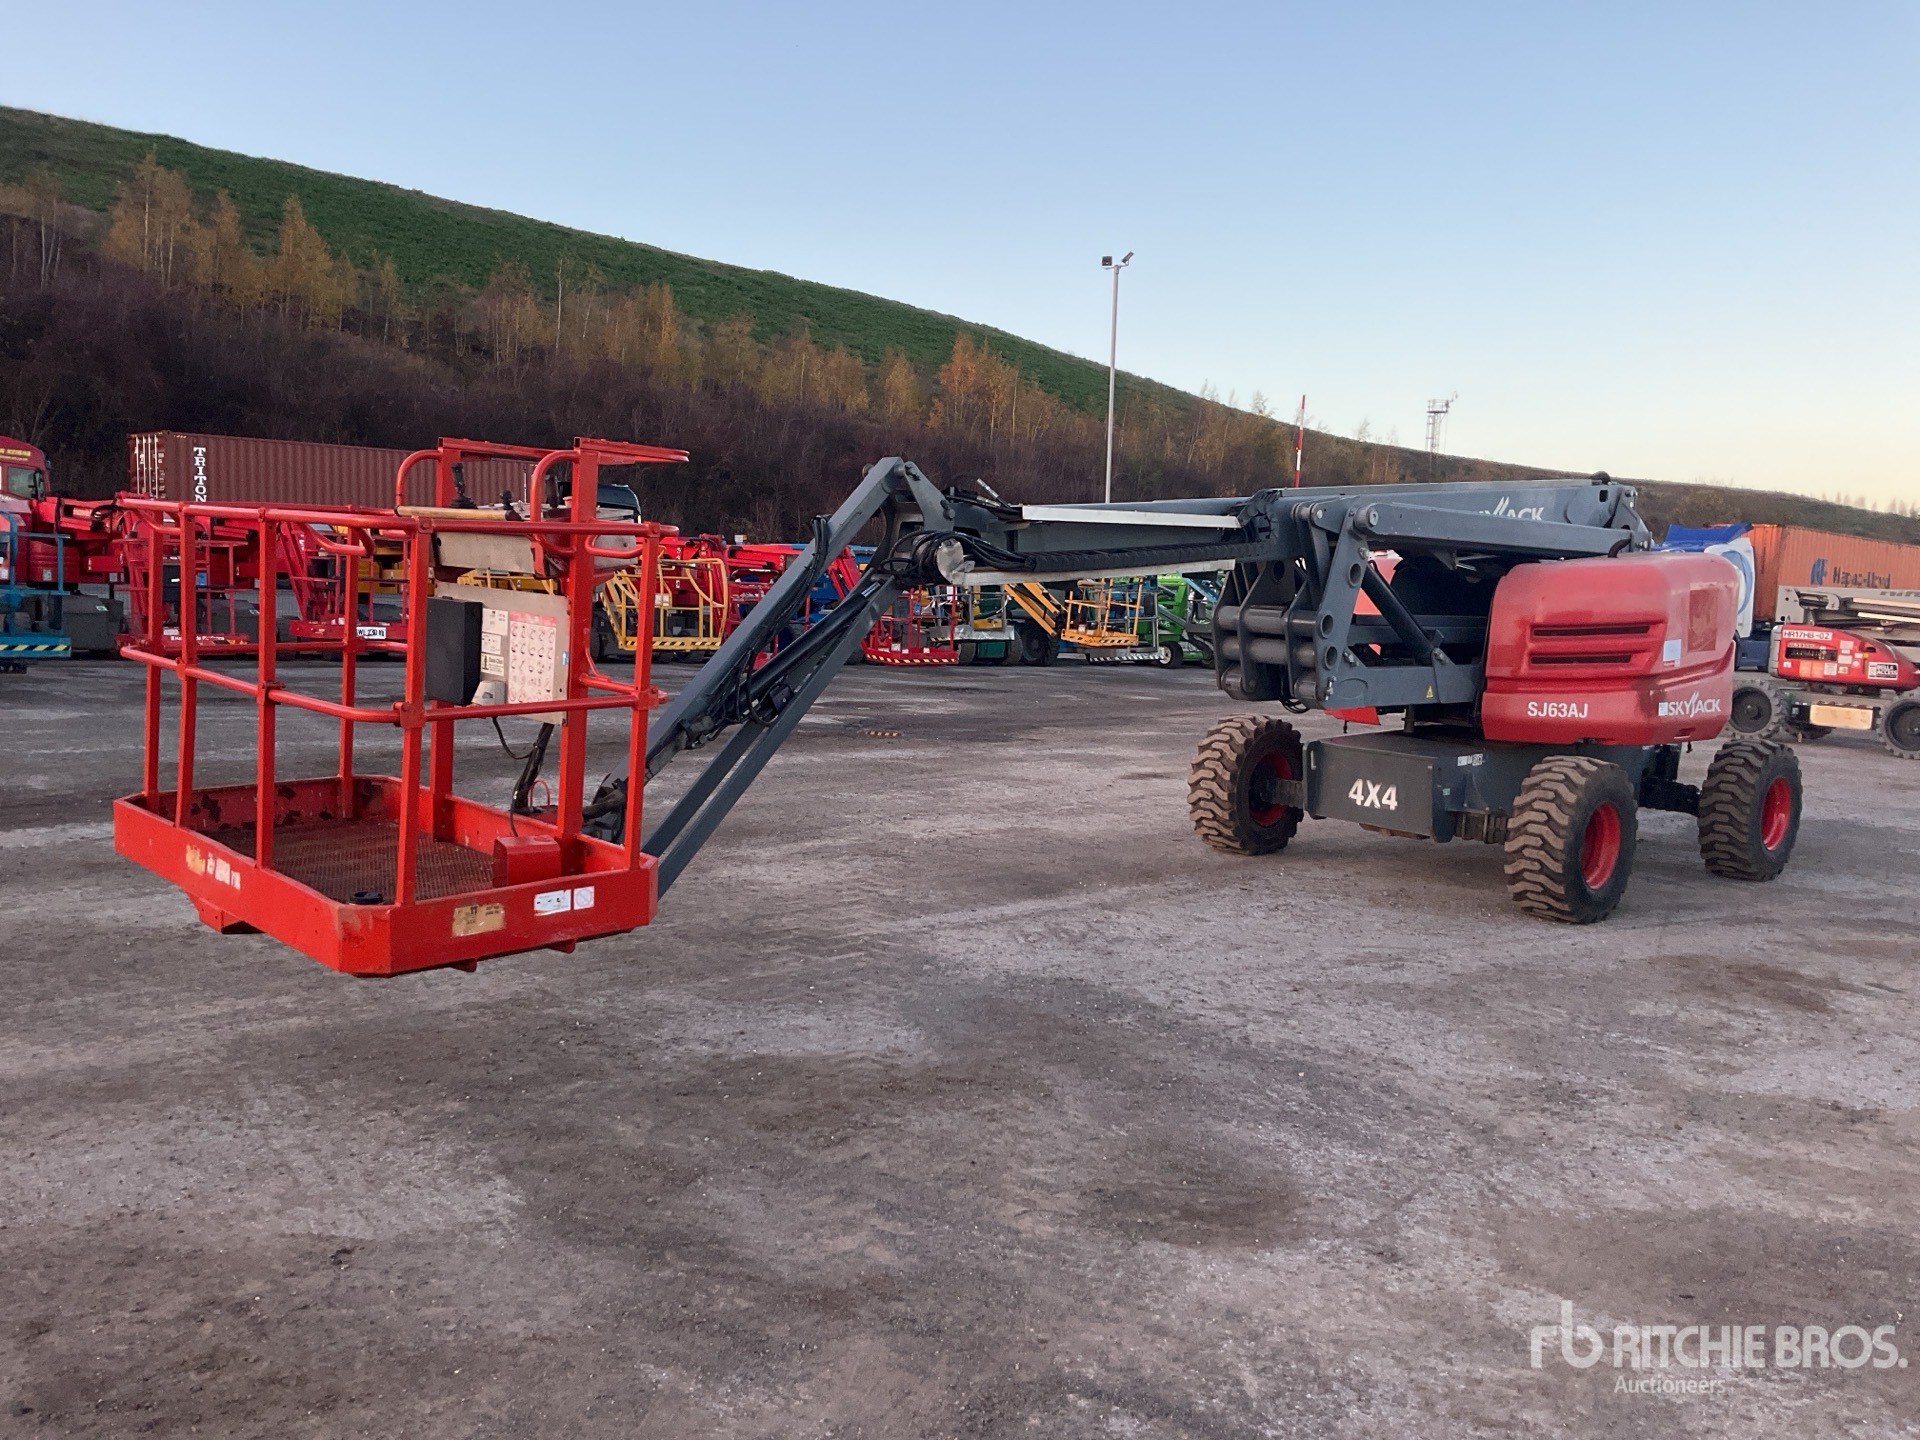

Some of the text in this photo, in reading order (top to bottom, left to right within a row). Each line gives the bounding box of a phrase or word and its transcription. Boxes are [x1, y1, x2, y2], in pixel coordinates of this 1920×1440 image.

[193, 447, 207, 502] TRITON
[1527, 701, 1589, 719] SJ63AJ
[1668, 691, 1721, 718] SKYJACK
[1348, 778, 1398, 811] 4X4
